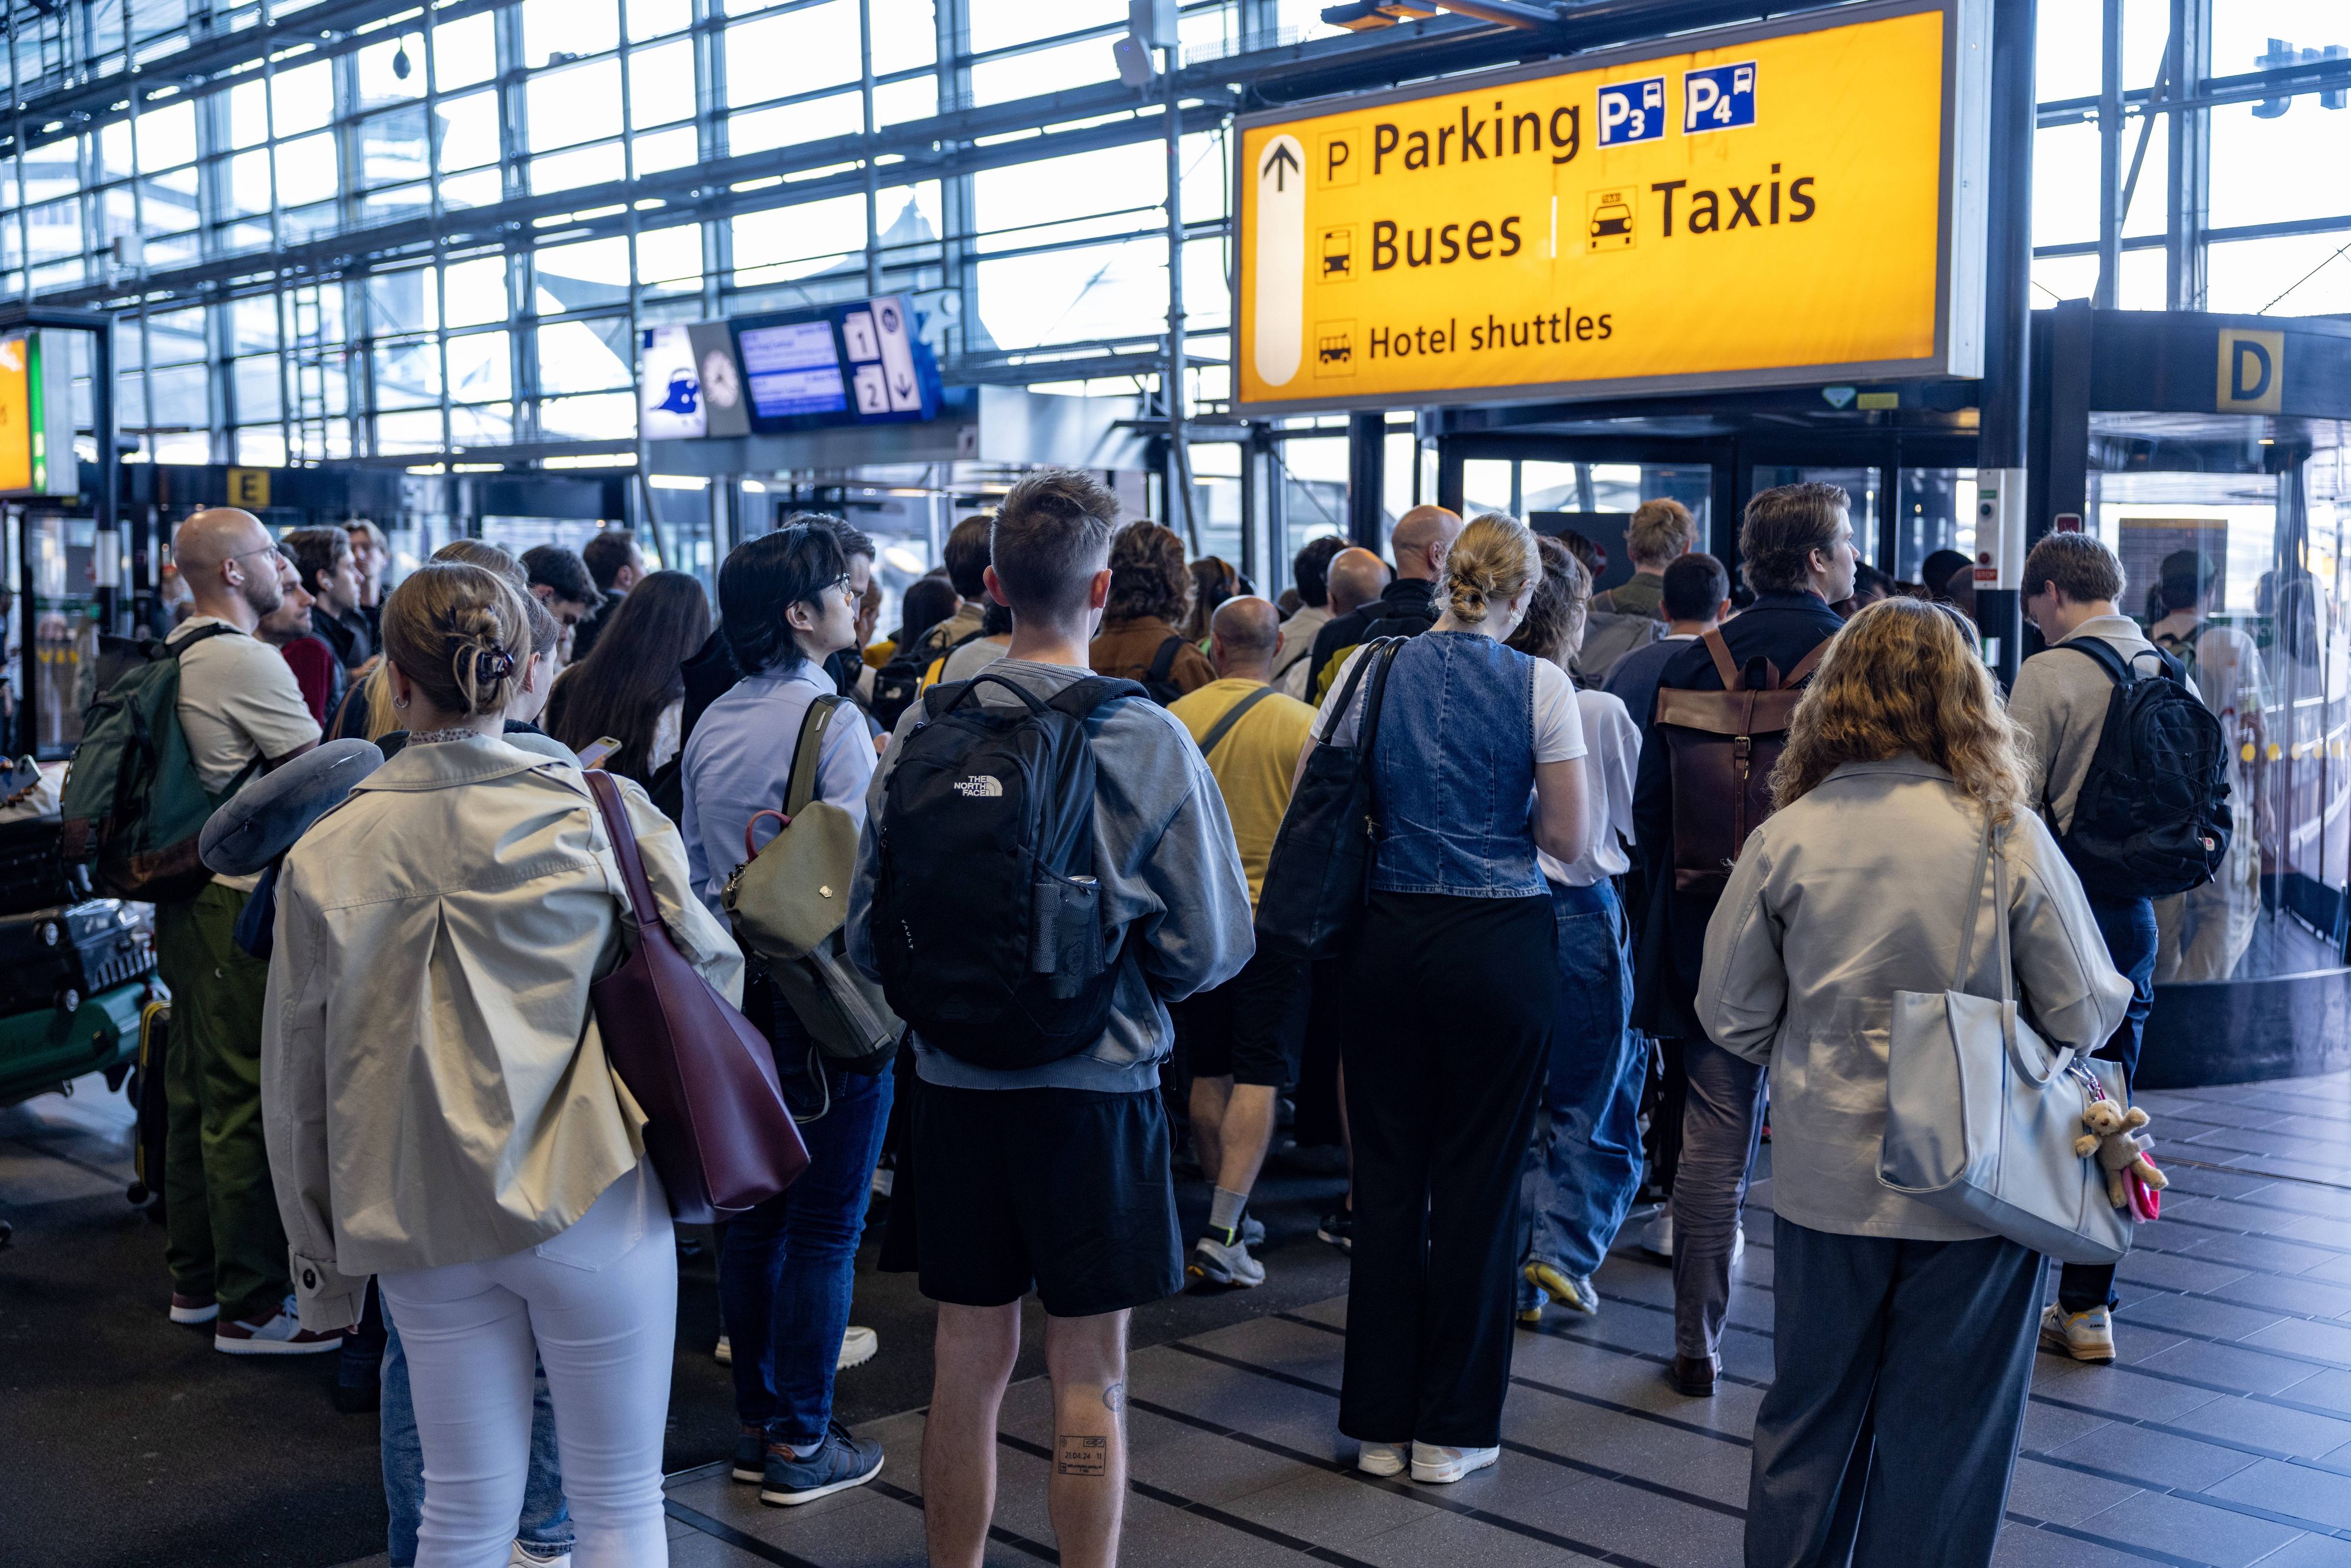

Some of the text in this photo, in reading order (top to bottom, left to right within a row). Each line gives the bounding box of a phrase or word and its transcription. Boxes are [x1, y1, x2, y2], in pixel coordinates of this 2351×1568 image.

[1600, 92, 1645, 142] P3
[1687, 77, 1733, 129] P4
[1374, 101, 1580, 175] Parking
[1651, 163, 1816, 237] Taxis
[1372, 216, 1521, 272] Buses
[857, 331, 868, 353] 1
[1370, 307, 1612, 359] Hotel shuttles
[865, 383, 879, 407] 2
[2231, 340, 2272, 402] D
[242, 475, 257, 501] E
[901, 919, 913, 949] VAULT
